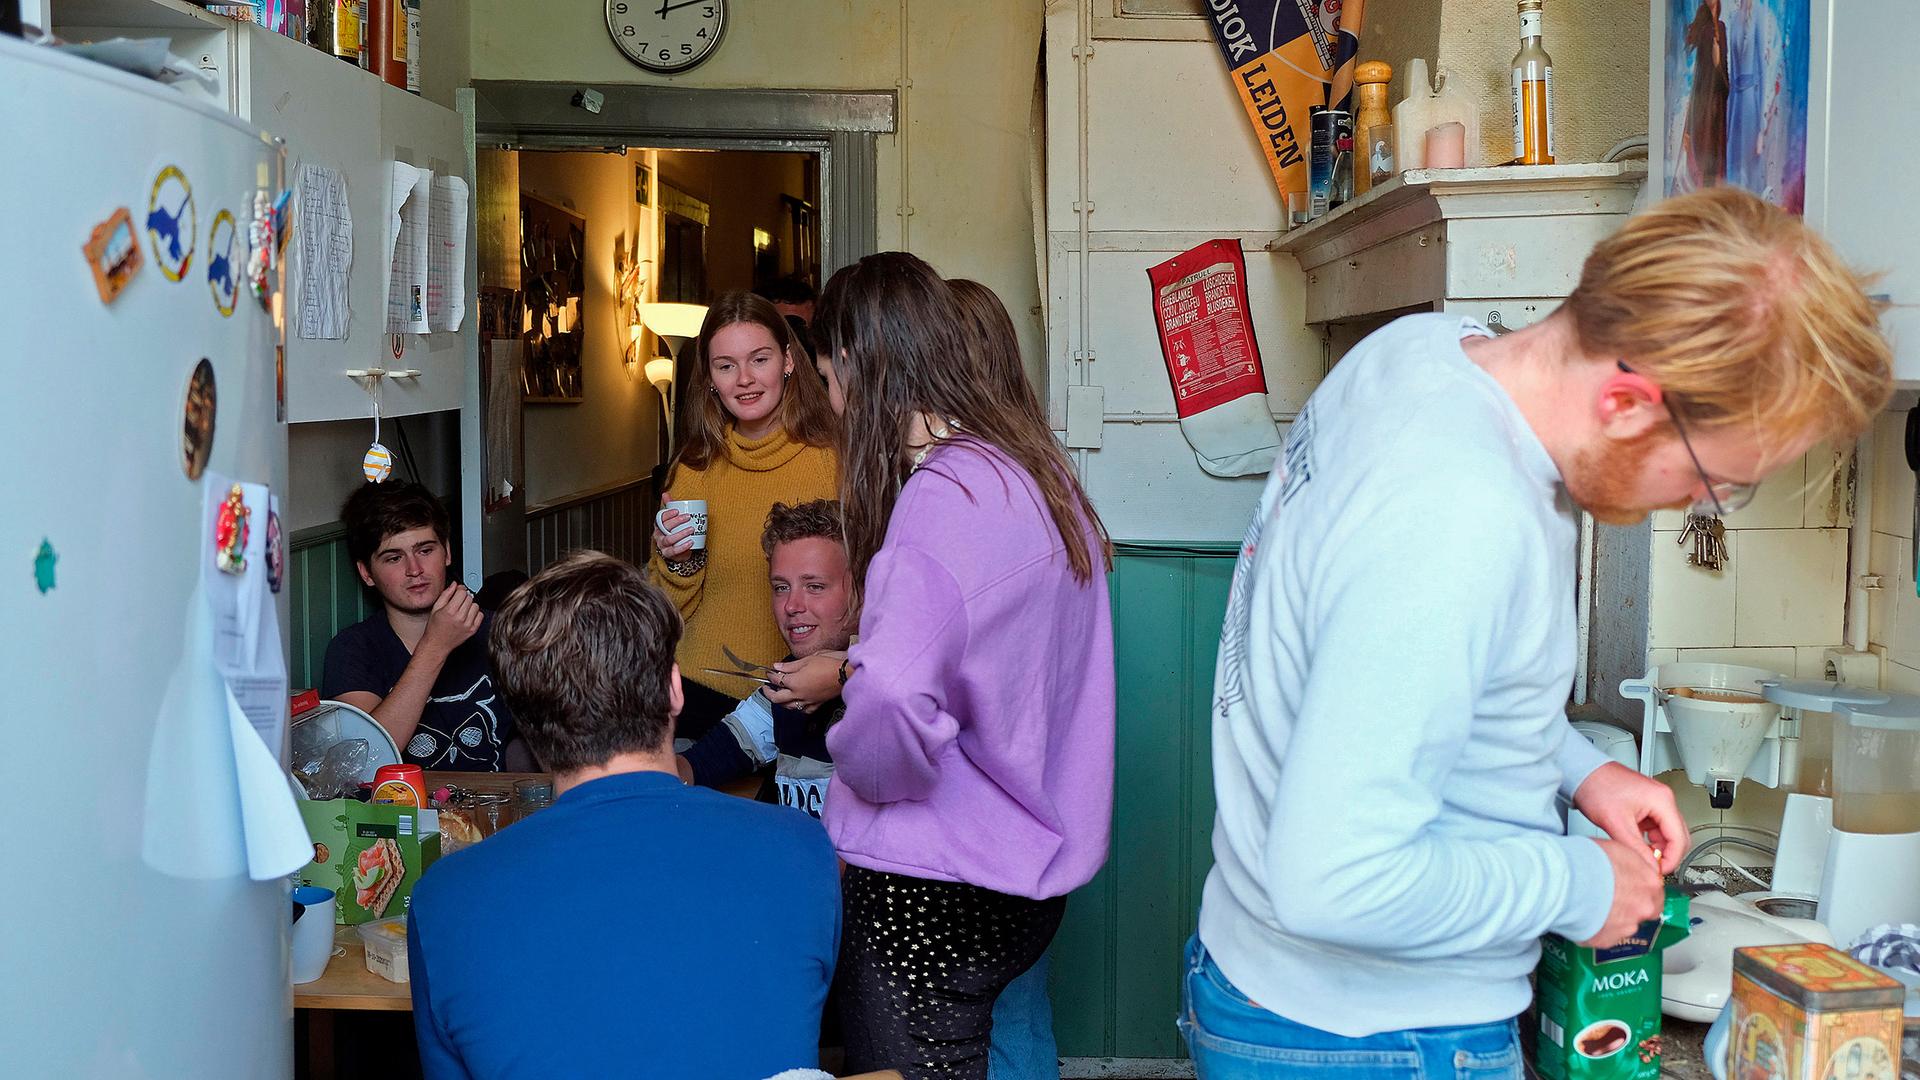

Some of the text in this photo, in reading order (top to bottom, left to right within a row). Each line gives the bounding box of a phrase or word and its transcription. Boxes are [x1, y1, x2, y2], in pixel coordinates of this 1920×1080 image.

[616, 3, 628, 14] 9
[702, 6, 714, 18] 3
[623, 25, 635, 37] 8
[696, 27, 707, 39] 4
[639, 42, 649, 54] 7
[680, 43, 692, 55] 5
[659, 49, 670, 61] 6
[1241, 62, 1304, 169] LEIDEN
[1162, 286, 1194, 308] FIREBLANKET
[1204, 285, 1231, 303] BRANDFILT
[1207, 296, 1236, 315] BLUSDEKEN
[1592, 968, 1649, 993] MOKA
